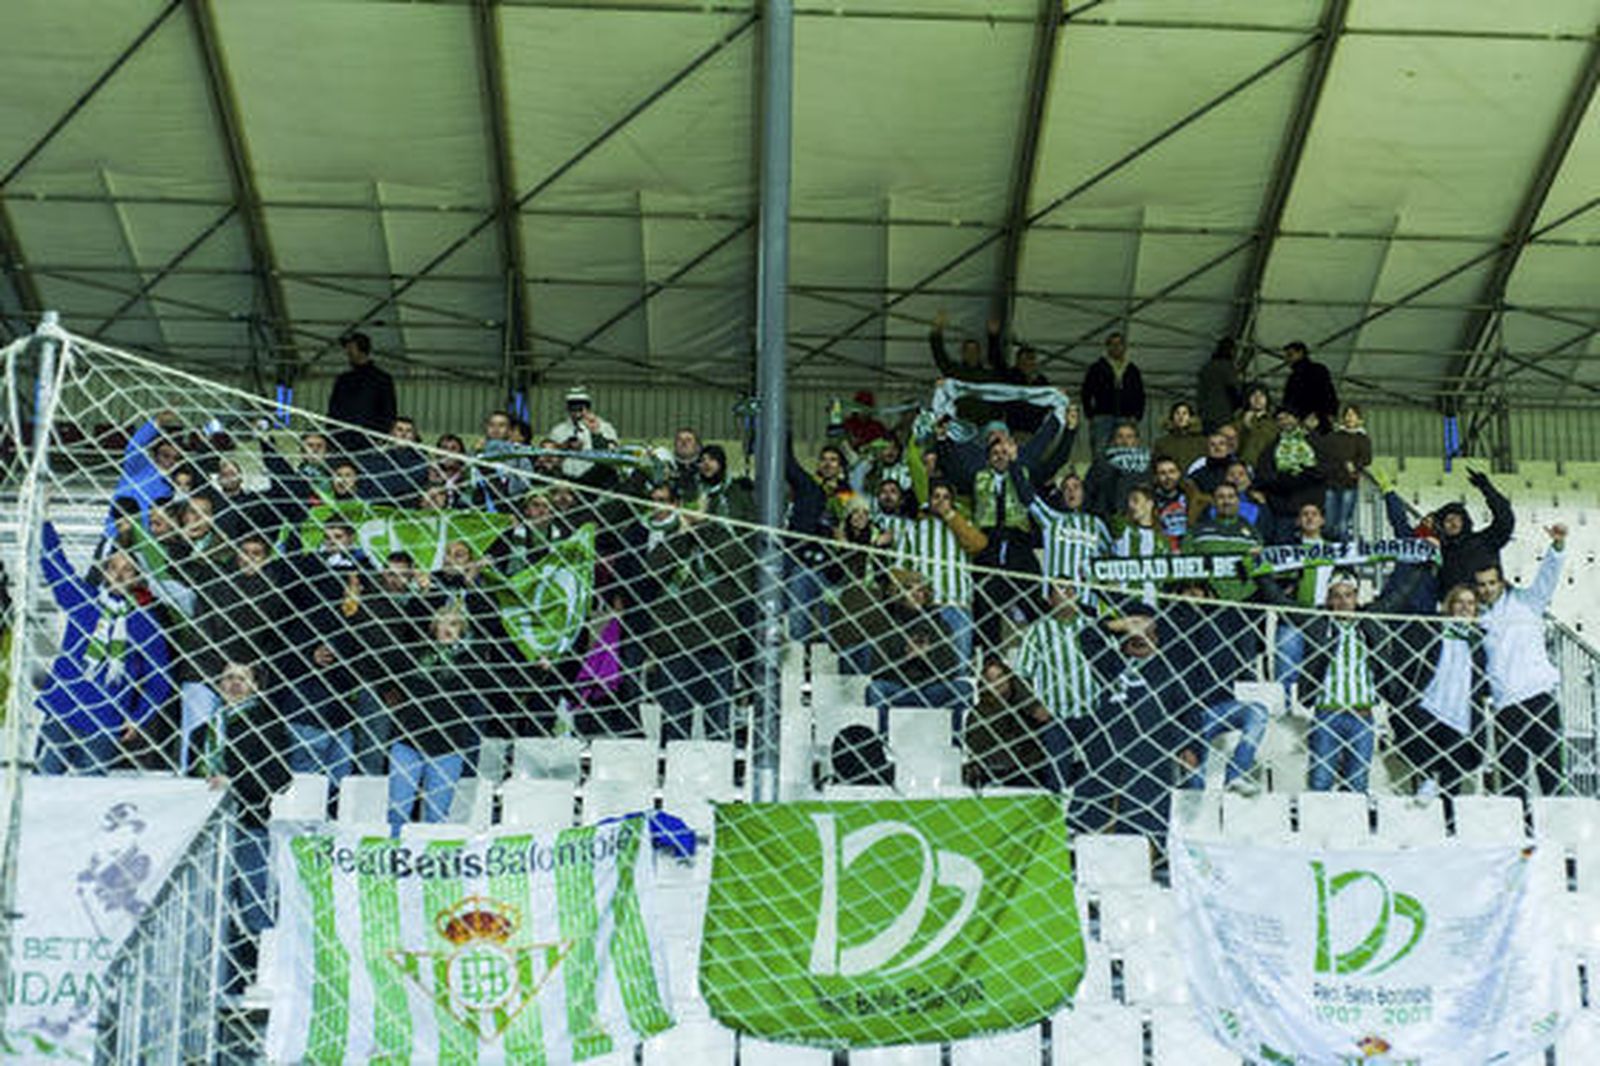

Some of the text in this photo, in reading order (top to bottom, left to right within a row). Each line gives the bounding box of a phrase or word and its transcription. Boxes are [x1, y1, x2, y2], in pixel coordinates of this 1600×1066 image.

[1095, 555, 1243, 580] CIUDAD DEL BE
[23, 937, 113, 961] BETIC
